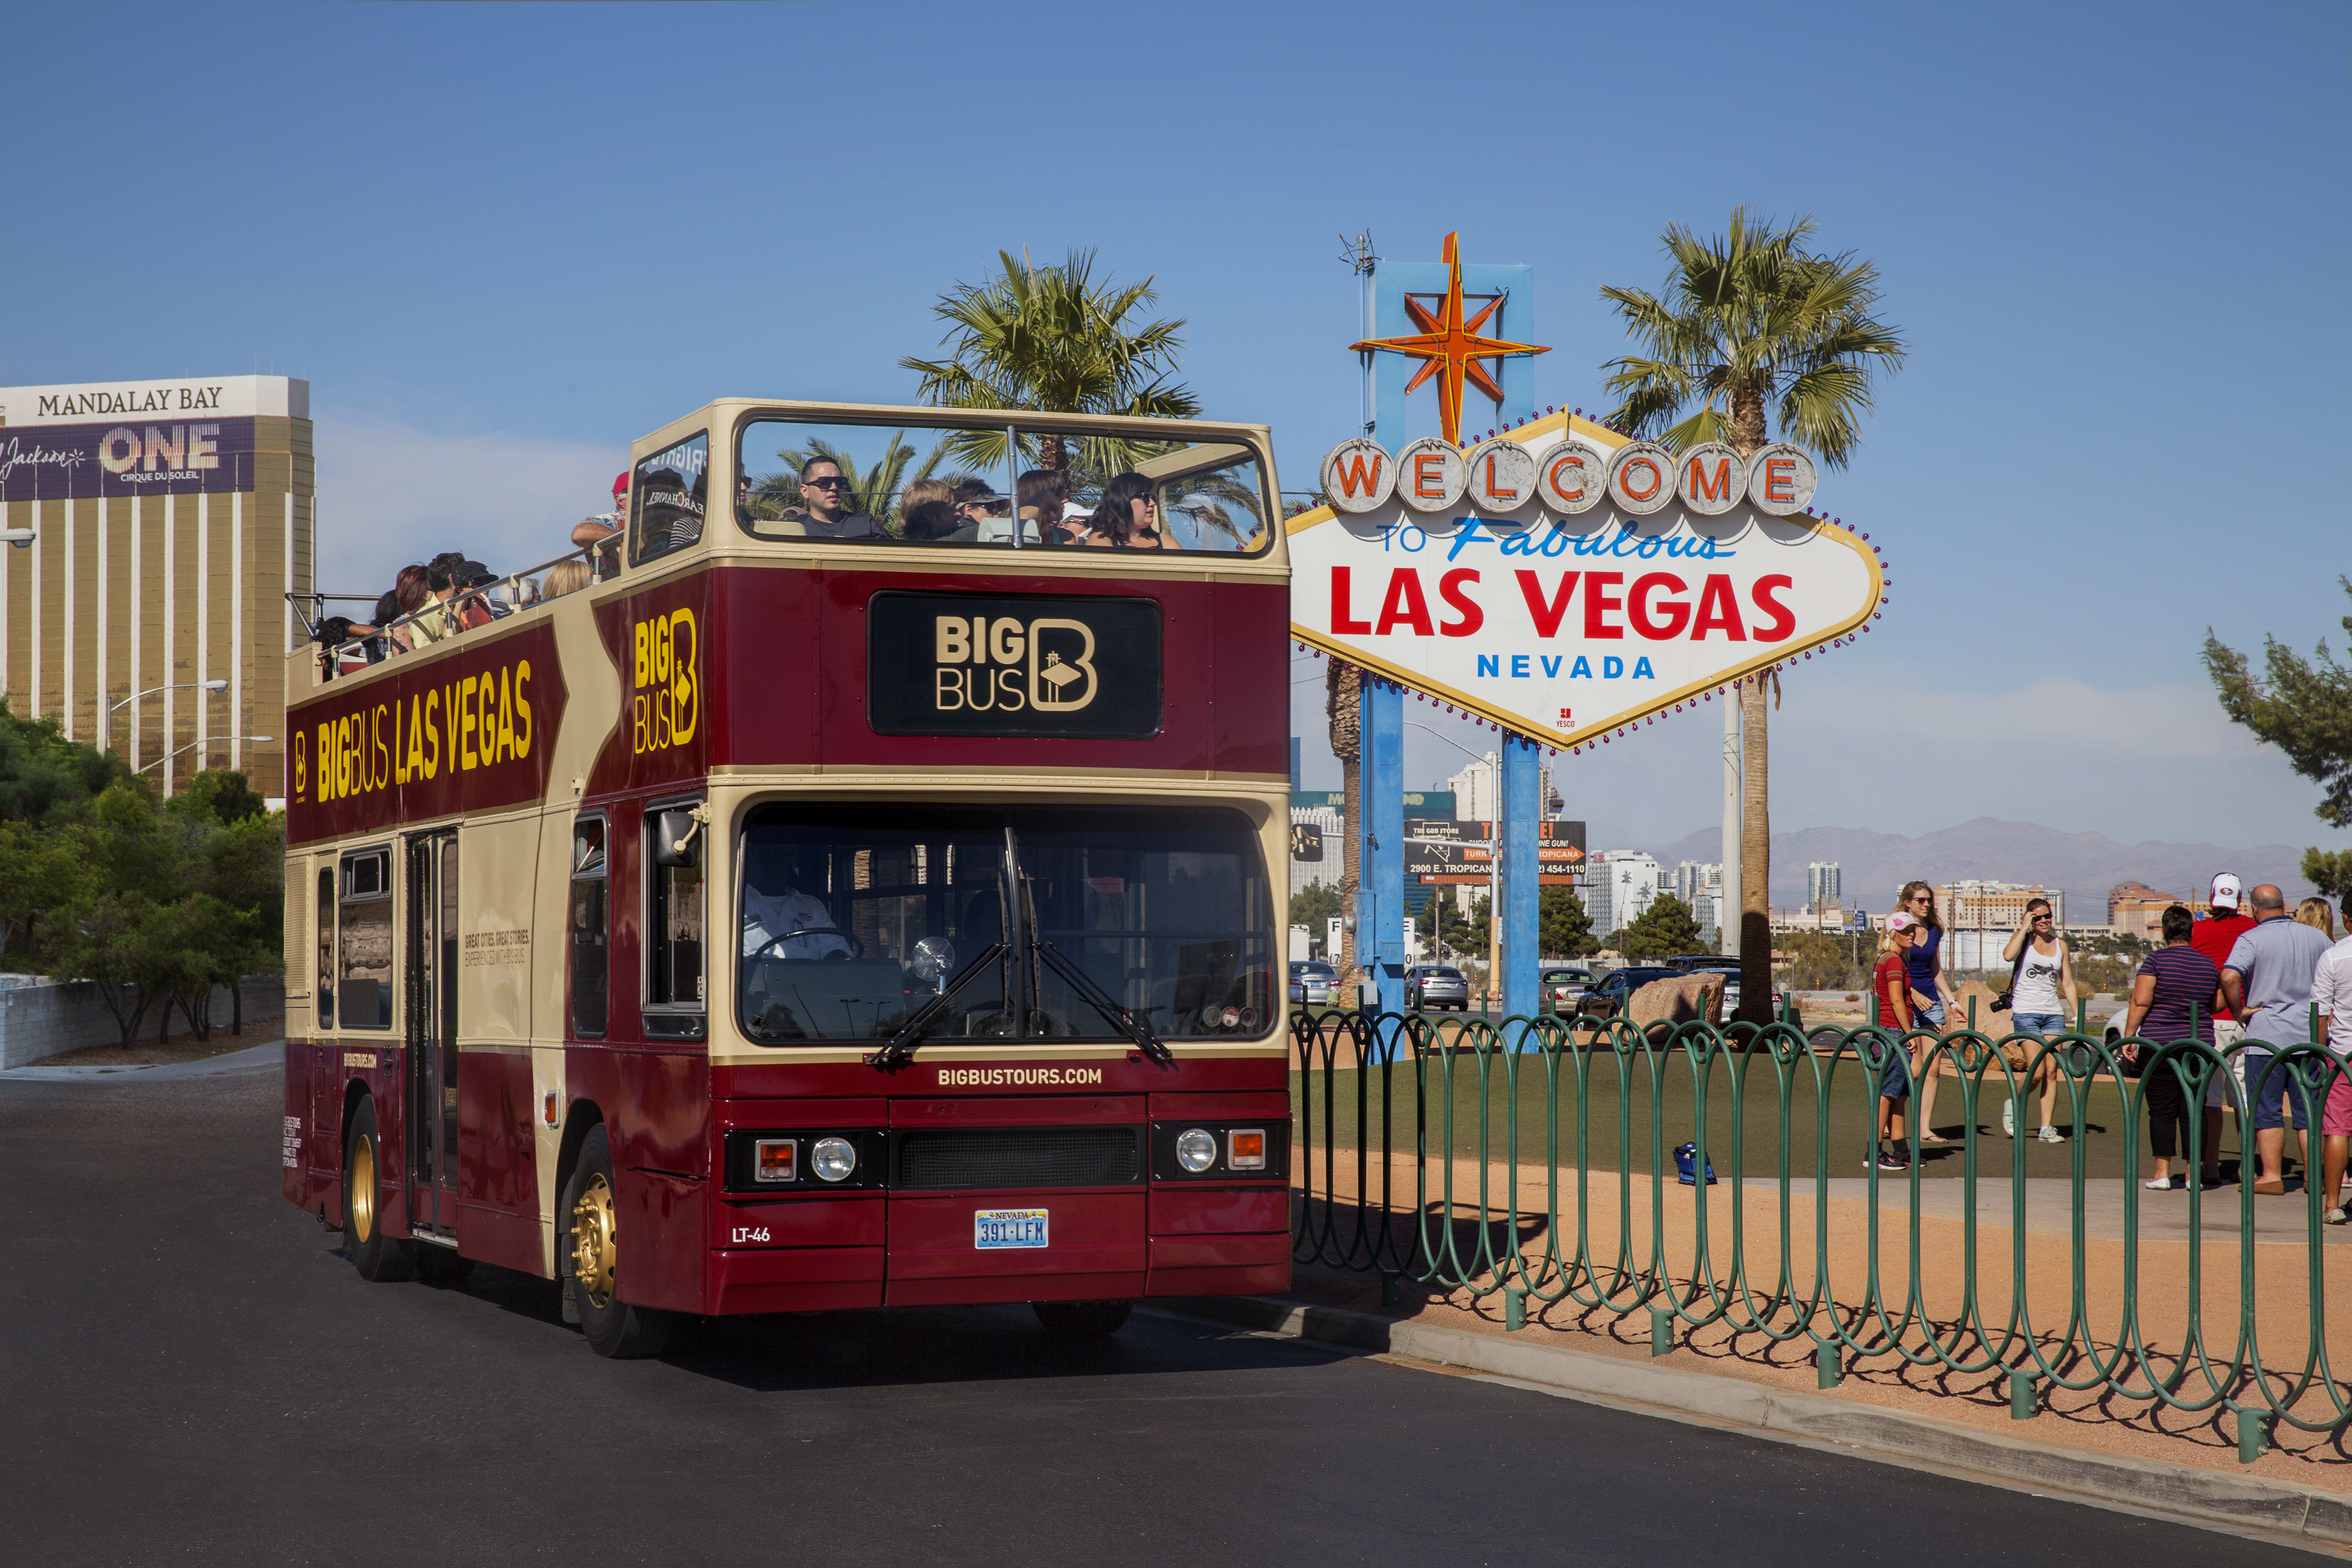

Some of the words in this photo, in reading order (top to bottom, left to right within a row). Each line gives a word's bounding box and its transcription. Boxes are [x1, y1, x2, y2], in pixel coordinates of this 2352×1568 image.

[38, 389, 172, 416] MANDALAY
[179, 387, 222, 409] BAY
[99, 423, 220, 474] ONE
[120, 472, 153, 483] CIRQUE
[169, 471, 199, 480] SOLEIL
[1335, 453, 1796, 503] WELCOME
[1377, 525, 1426, 552] TO
[1447, 517, 1736, 561] Fabulous
[1331, 566, 1484, 637] LAS
[1514, 569, 1796, 642] VEGAS
[635, 614, 669, 689] BIG
[936, 616, 1024, 664] BIG
[1477, 654, 1655, 679] NEVADA
[936, 668, 1025, 711] BUS
[395, 689, 439, 785] LAS
[445, 659, 531, 774] VEGAS
[635, 689, 670, 754] BUS
[1410, 864, 1431, 873] 2900
[1444, 864, 1492, 873] TROPICAN
[1547, 865, 1585, 873] 454-1110
[938, 1068, 1102, 1085] BIGBUSTOURS.COM
[732, 1227, 770, 1243] LT-46
